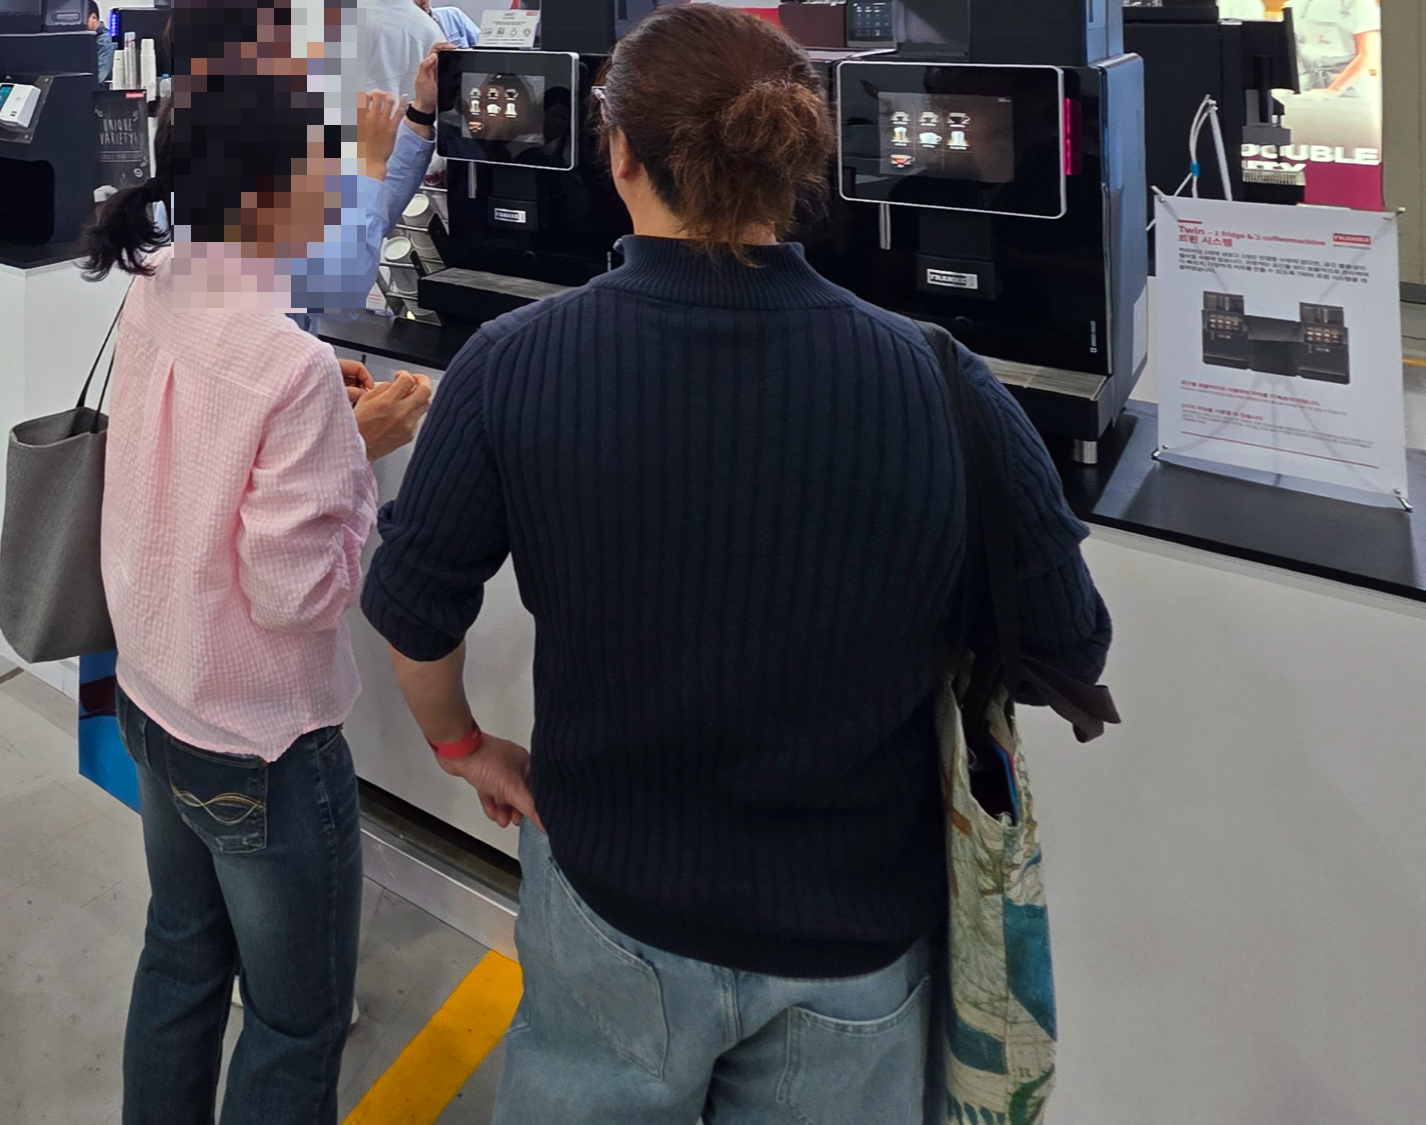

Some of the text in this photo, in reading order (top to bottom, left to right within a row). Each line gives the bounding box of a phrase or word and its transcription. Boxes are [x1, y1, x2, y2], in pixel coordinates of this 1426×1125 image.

[102, 118, 133, 131] UNIQUE
[1178, 225, 1205, 235] Twin
[1221, 231, 1246, 239] fridge
[1178, 234, 1233, 247] 트윈 시스템
